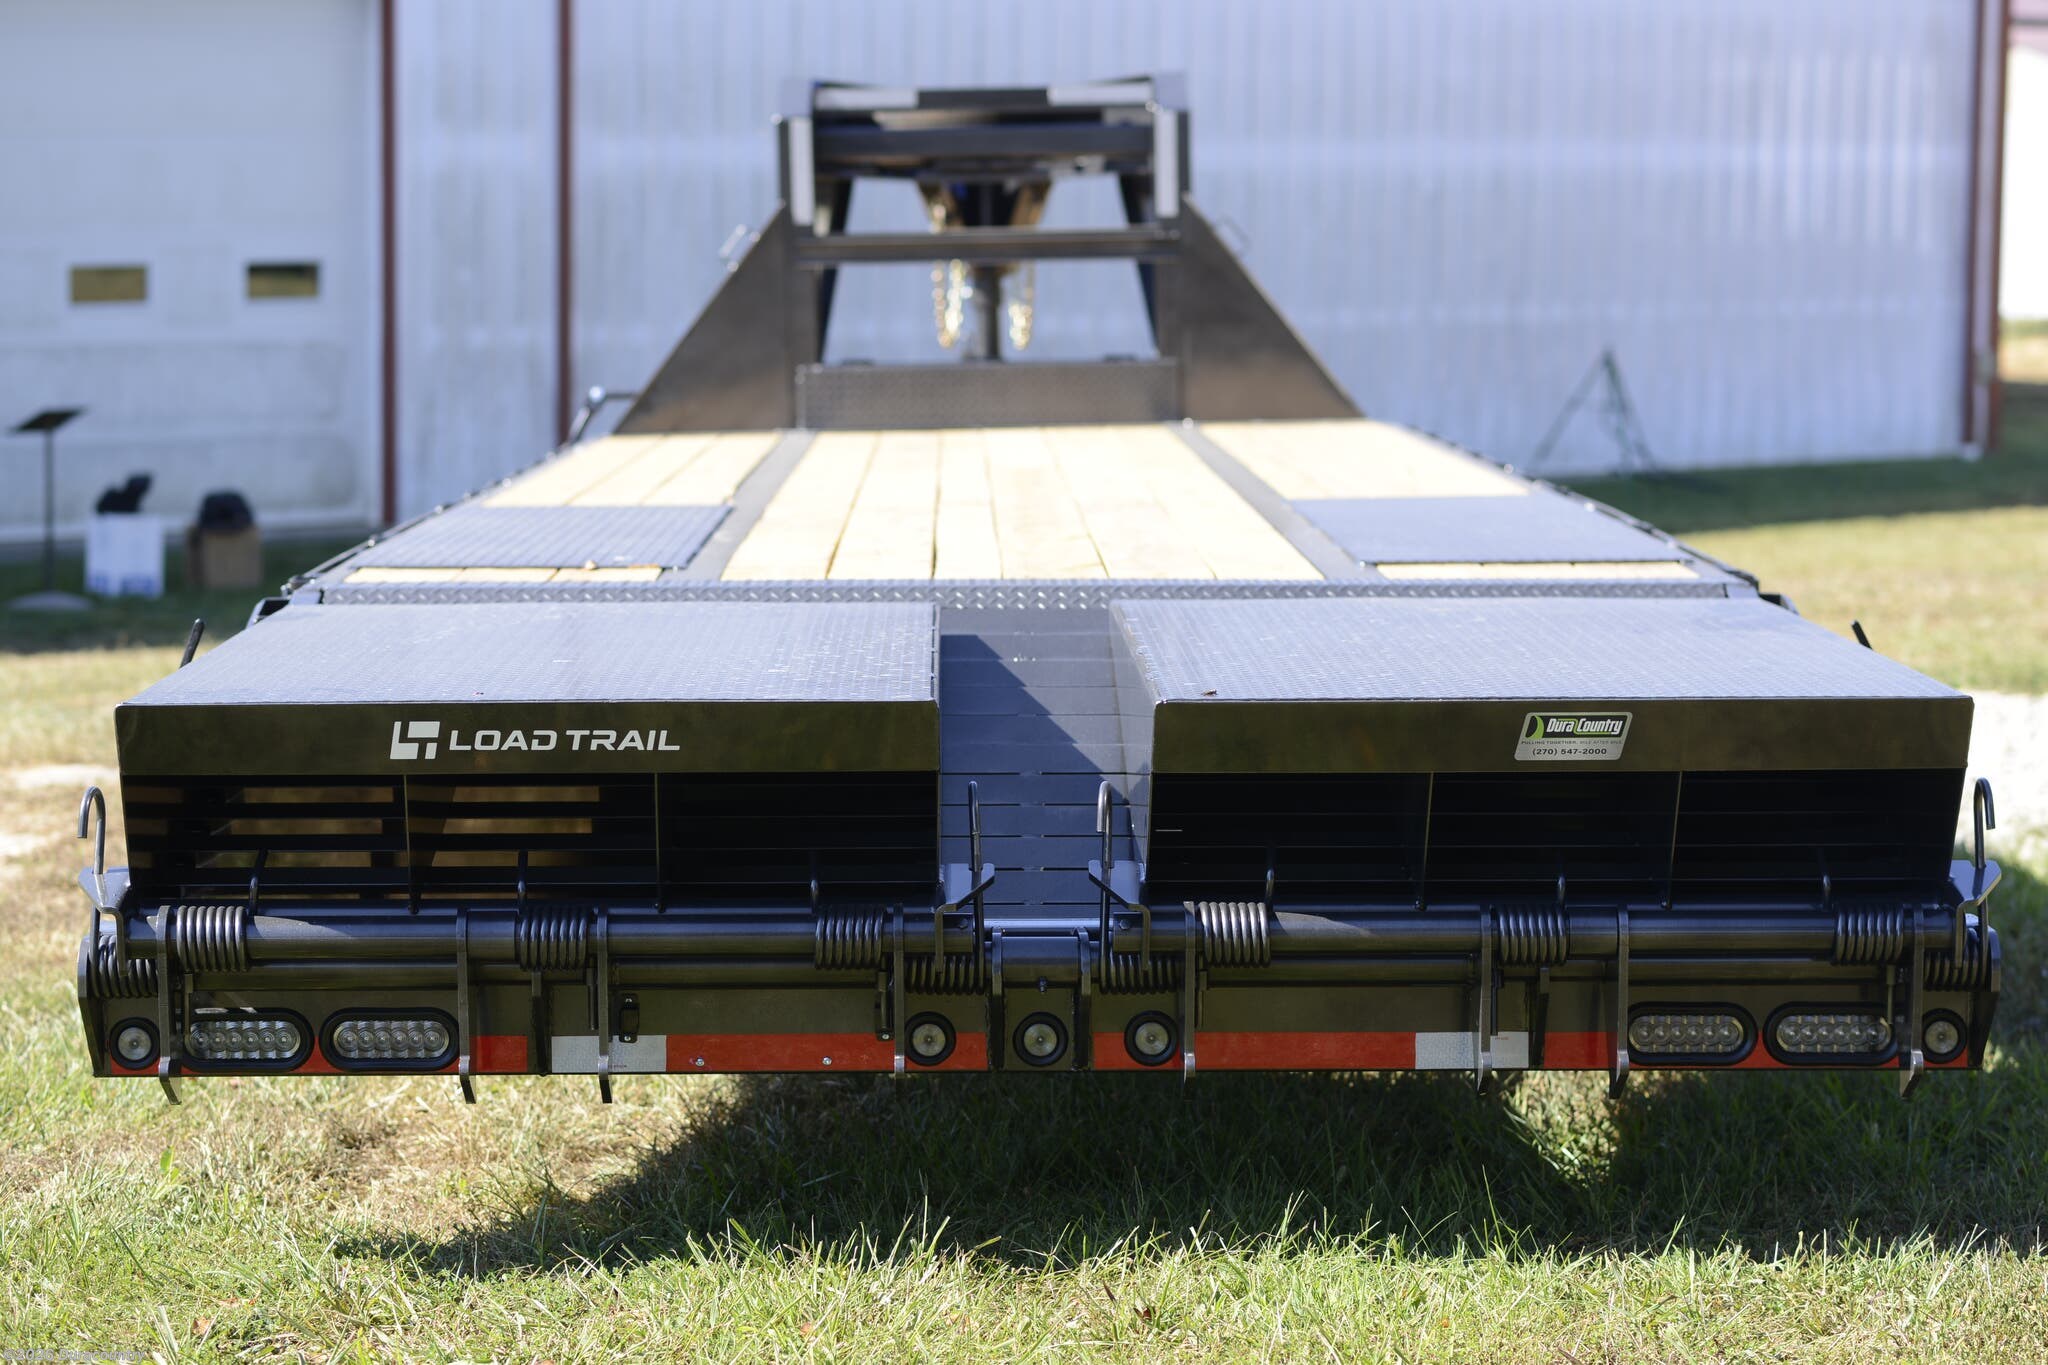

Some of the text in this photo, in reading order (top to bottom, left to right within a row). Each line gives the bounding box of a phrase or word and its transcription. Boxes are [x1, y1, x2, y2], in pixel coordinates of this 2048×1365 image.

[1546, 718, 1623, 735] Dura Country
[449, 730, 681, 751] LOAD TRAIL
[1532, 748, 1607, 756] (270) 547-2000
